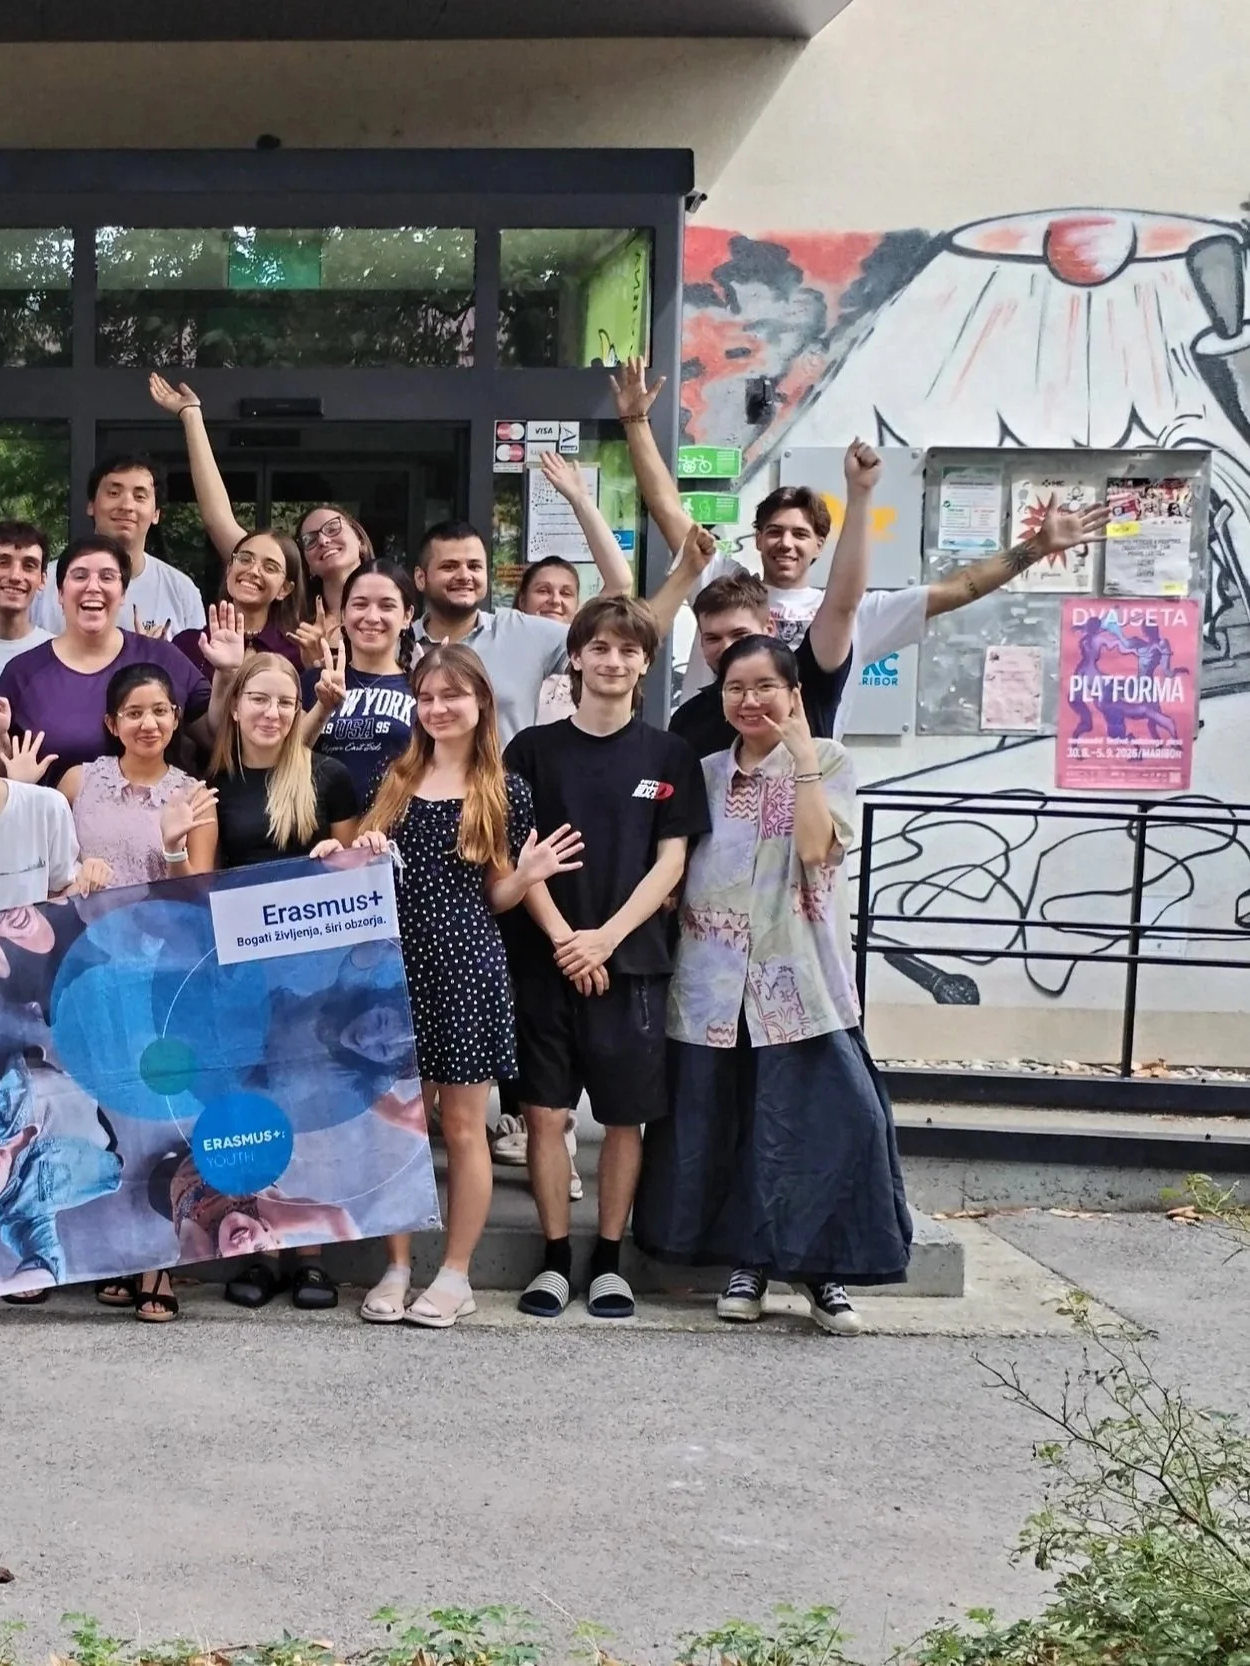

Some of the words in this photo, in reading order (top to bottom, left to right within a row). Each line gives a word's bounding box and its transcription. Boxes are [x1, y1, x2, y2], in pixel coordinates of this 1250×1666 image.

[1071, 607, 1188, 627] DVAJSETA
[362, 687, 417, 727] YORK
[335, 718, 375, 740] USA
[375, 721, 391, 734] 95
[262, 890, 383, 926] Erasmus+
[237, 933, 272, 947] Bogati
[275, 926, 323, 944] življenja,
[325, 923, 342, 934] širi
[344, 915, 387, 930] obzorja.
[203, 1129, 285, 1152] ERASMUS+:
[206, 1151, 254, 1168] YOUTH
